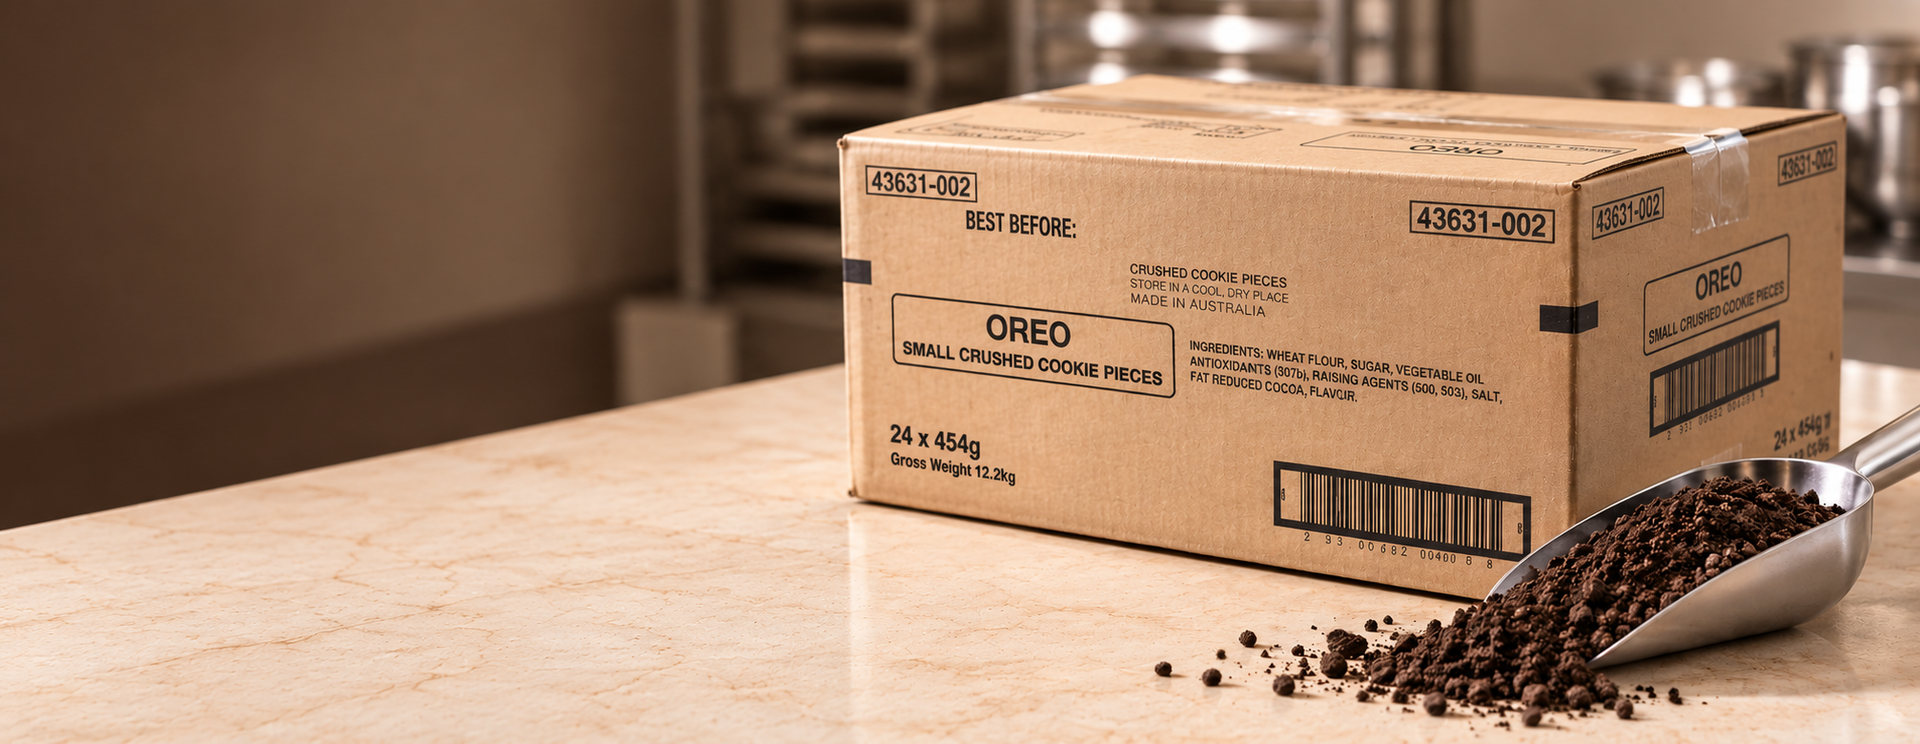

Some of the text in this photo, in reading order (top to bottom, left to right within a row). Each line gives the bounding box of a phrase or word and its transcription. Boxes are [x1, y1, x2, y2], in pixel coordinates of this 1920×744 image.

[1782, 146, 1834, 180] 43631-002
[872, 171, 970, 197] 43631-002
[966, 210, 1076, 238] BEST BEFORE:
[1417, 206, 1546, 237] 43631-002
[1596, 193, 1660, 232] 43631-002
[1130, 263, 1287, 288] CRUSHED COOKIE PIECES
[1130, 278, 1289, 304] STORE IN A COOL, DRY PLACE
[1695, 261, 1742, 300] OREO
[1130, 293, 1266, 318] MADE IN AUSTRALIA
[1648, 280, 1785, 344] SMALL CRUSHED COOKIE PIECES
[986, 314, 1071, 348] OREO
[902, 340, 1163, 386] SMALL CRUSHED COOKIE PIECES
[1189, 340, 1484, 385] INGREDIENTS: WHEAT FLOUR, SUGAR, VEGETABLE OIL
[1190, 356, 1272, 376] ANTIOXIDANTS
[1312, 370, 1358, 386] RAISING
[1362, 376, 1409, 392] AGENTS
[1471, 388, 1502, 404] SALT,
[1190, 370, 1210, 384] FAT
[1212, 374, 1262, 391] REDUCED
[1265, 381, 1308, 399] COCOA,
[890, 424, 981, 460] 24 x 454g
[1774, 427, 1788, 452] 24
[1790, 427, 1796, 444] x
[1798, 414, 1822, 439] 454g
[890, 452, 1016, 486] Gross Weight 12.2kg
[1304, 532, 1310, 542] 2
